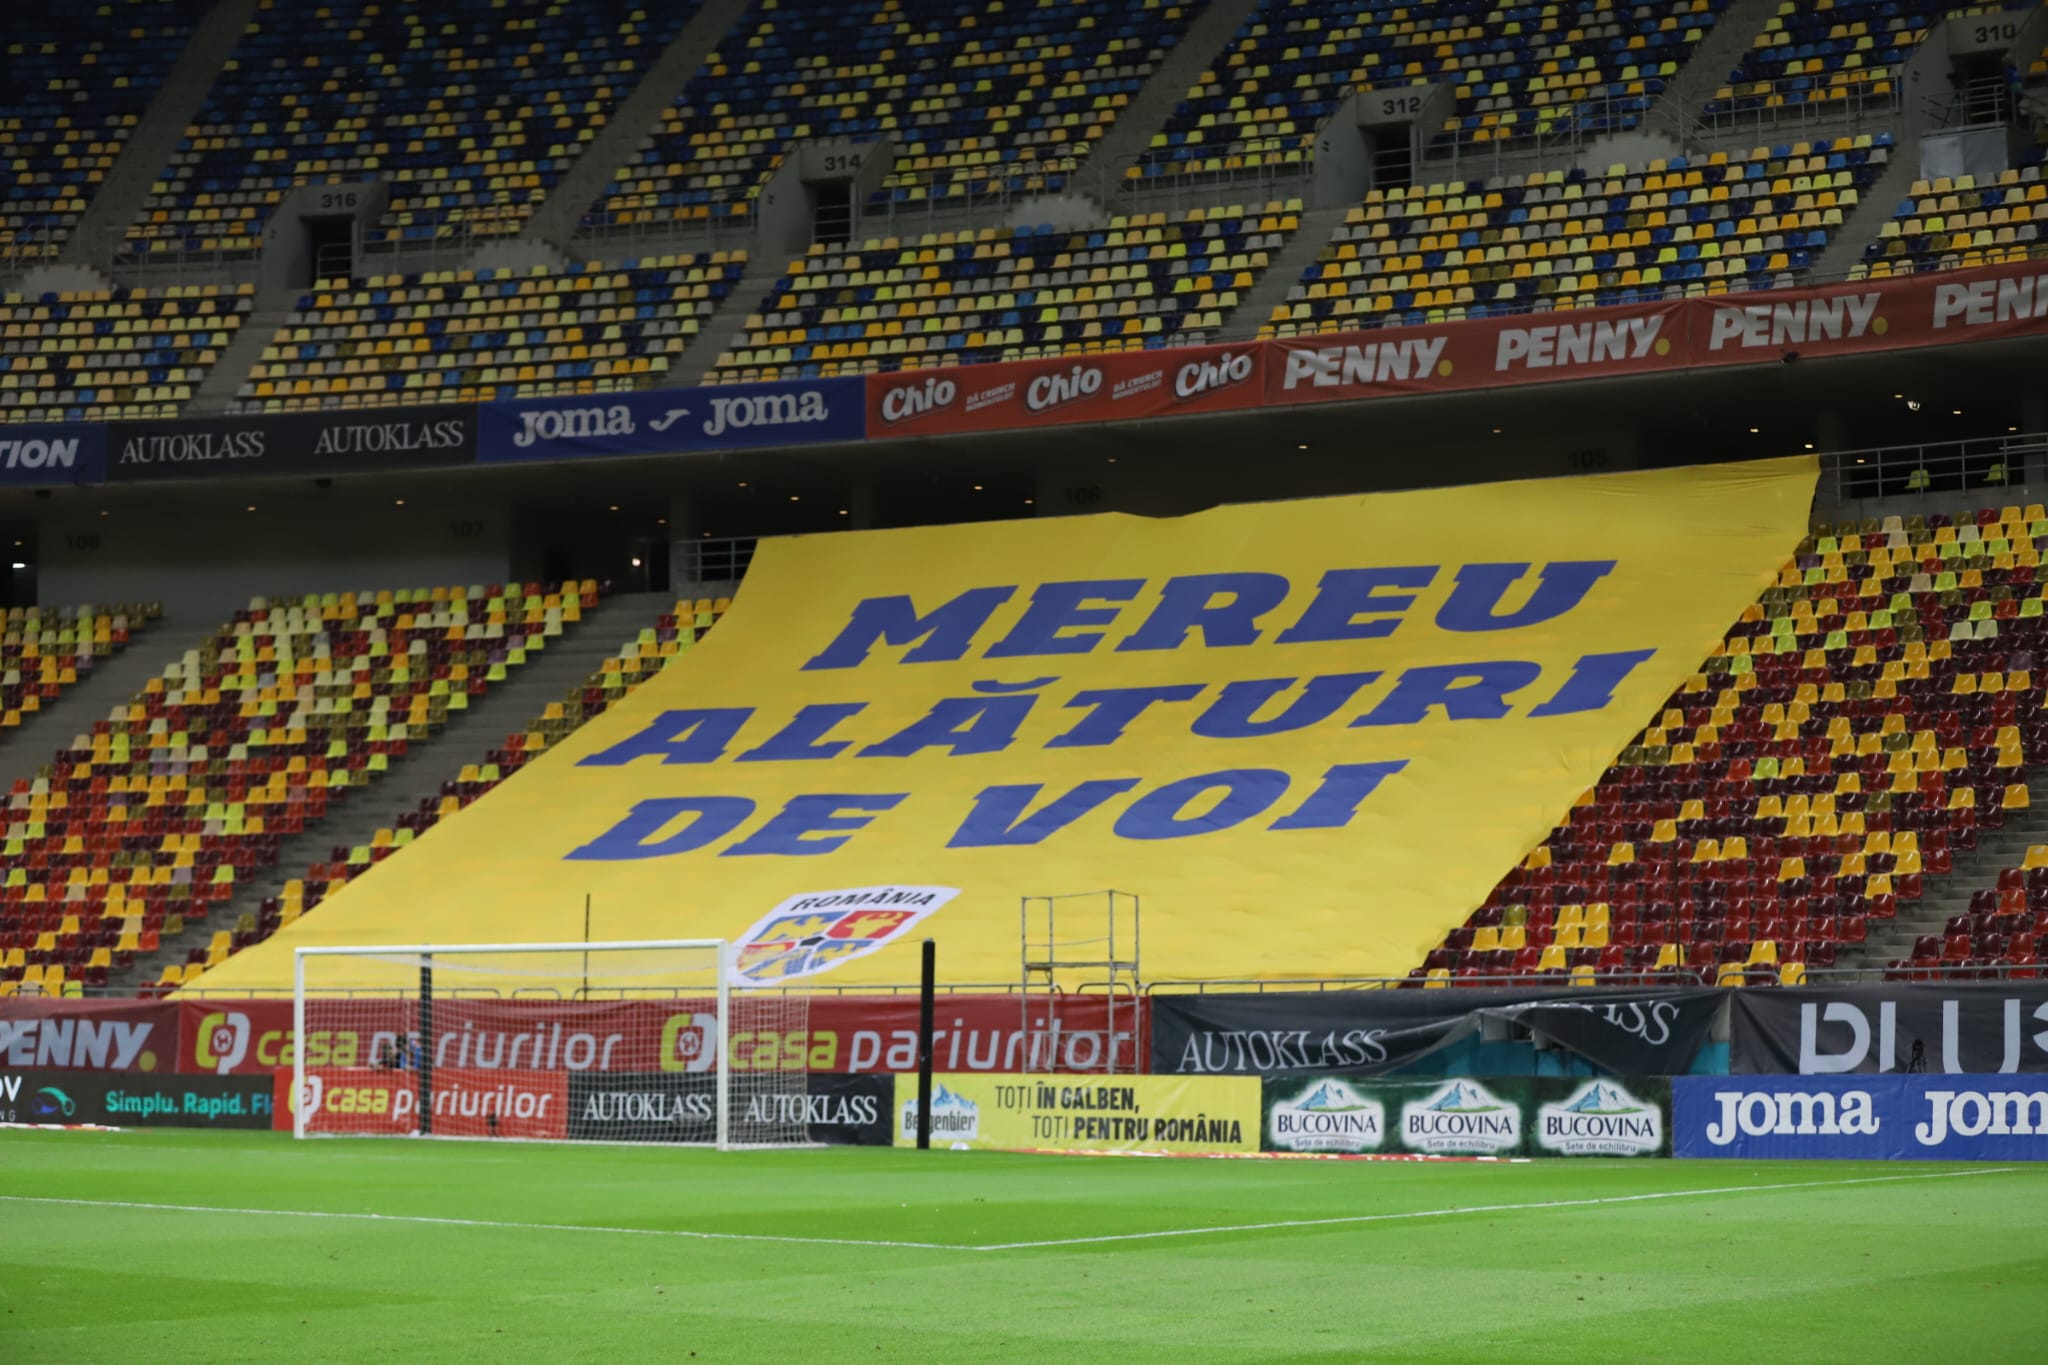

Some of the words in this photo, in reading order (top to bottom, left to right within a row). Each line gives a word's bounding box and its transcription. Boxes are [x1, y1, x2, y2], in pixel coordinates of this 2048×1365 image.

[1976, 24, 2015, 43] 310
[1383, 97, 1420, 115] 312
[825, 155, 860, 171] 314
[321, 192, 357, 208] 316
[1027, 366, 1102, 414] Chio
[1175, 352, 1252, 398] Chio
[703, 390, 829, 436] Joma
[882, 377, 956, 422] Chio
[313, 420, 464, 455] AUTOKLASS
[513, 405, 636, 447] Joma
[120, 431, 265, 464] AUTOKLASS
[800, 560, 1618, 671] MEREU
[574, 648, 1658, 766] ALĂTURI
[562, 793, 911, 860] DE
[945, 759, 1411, 848] VOI
[790, 888, 936, 911] ROMÂNIA
[257, 1031, 358, 1067] casa
[728, 1031, 838, 1069] casa
[1176, 1029, 1387, 1073] AUTOKLASS
[106, 1090, 179, 1118] Simplu.
[184, 1092, 247, 1119] Rapid.
[326, 1088, 389, 1113] casa
[582, 1092, 711, 1121] AUTOKLASS
[745, 1094, 878, 1124] AUTOKLASS
[1036, 1081, 1056, 1109] ÎN
[1061, 1086, 1140, 1114] GALBEN,
[1074, 1116, 1149, 1141] PENTRU
[1154, 1114, 1242, 1143] ROMÂNIA
[1278, 1114, 1377, 1133] BUCOVINA
[1409, 1115, 1513, 1134] BUCOVINA
[1547, 1116, 1655, 1137] BUCOVINA
[1706, 1090, 1880, 1146] Joma
